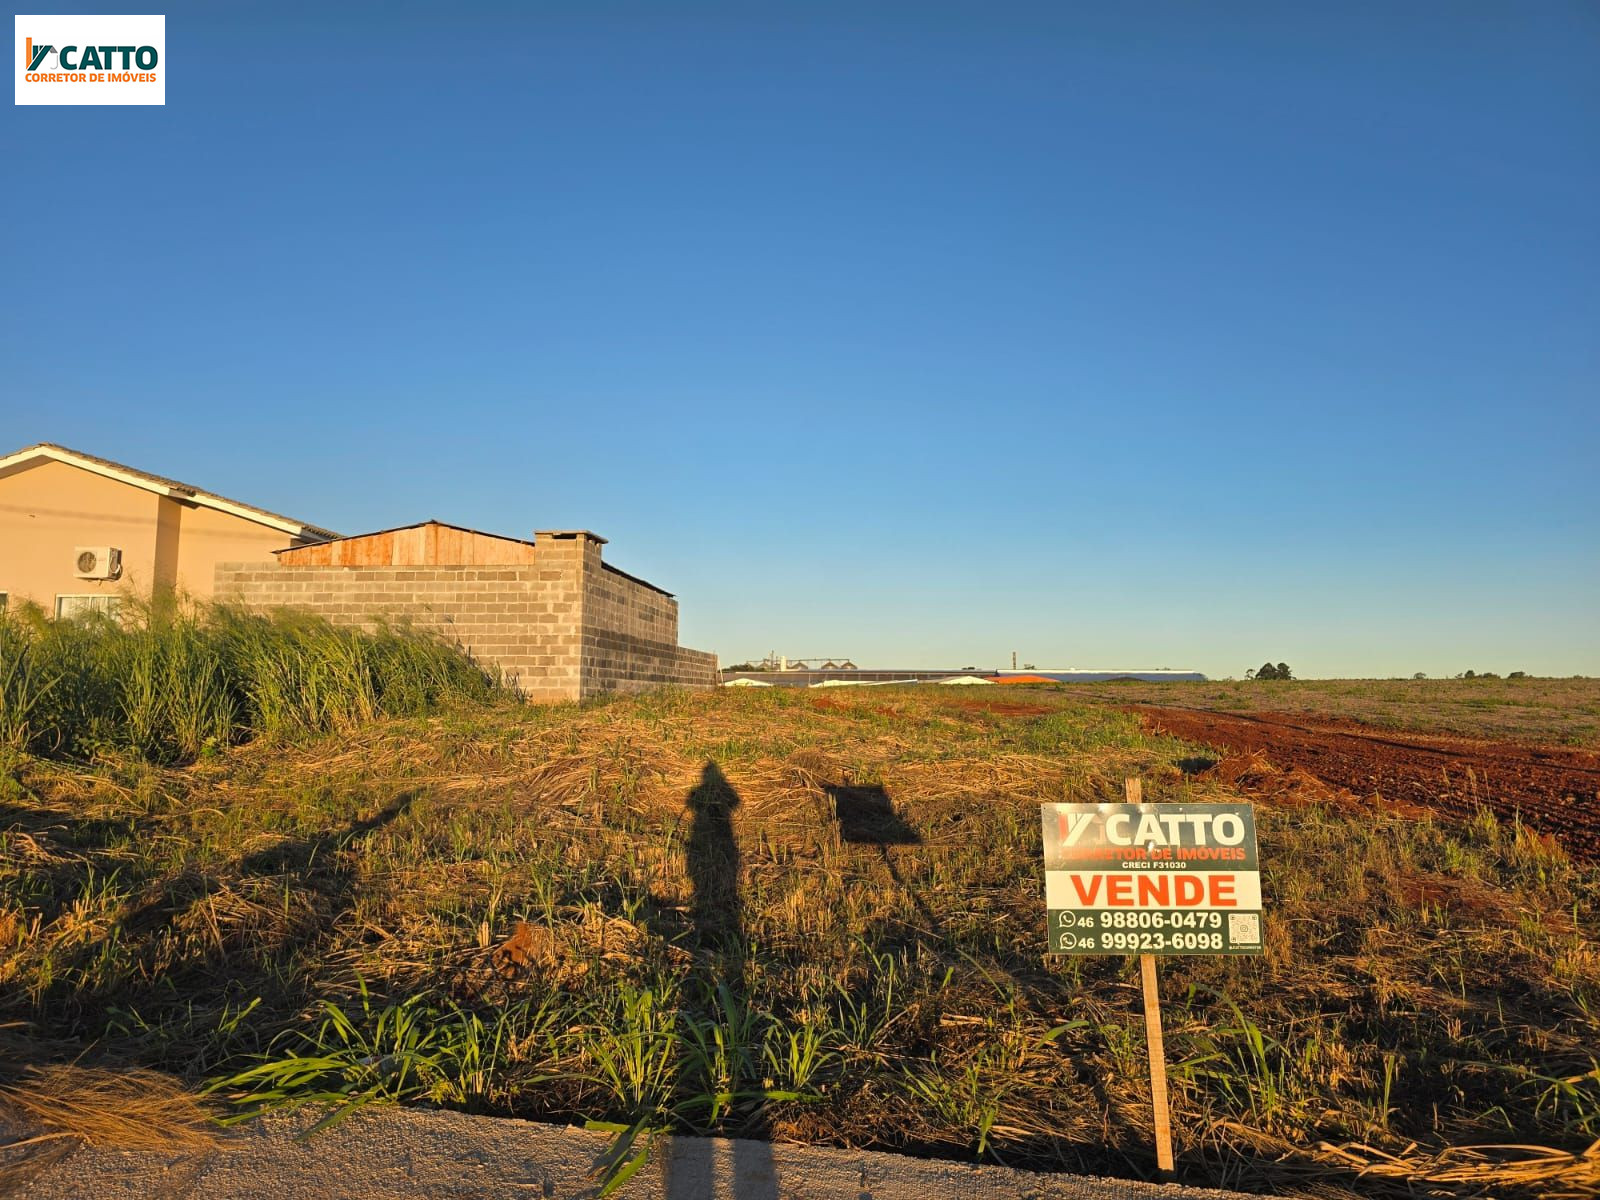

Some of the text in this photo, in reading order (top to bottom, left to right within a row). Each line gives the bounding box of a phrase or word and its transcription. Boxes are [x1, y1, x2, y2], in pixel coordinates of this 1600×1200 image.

[1177, 845, 1247, 861] IMÓVEIS
[1122, 861, 1151, 869] CRECI
[1069, 874, 1238, 907] VENDE
[1077, 911, 1222, 929] 46 98806-0479
[1078, 932, 1223, 950] 46 99923-6098
